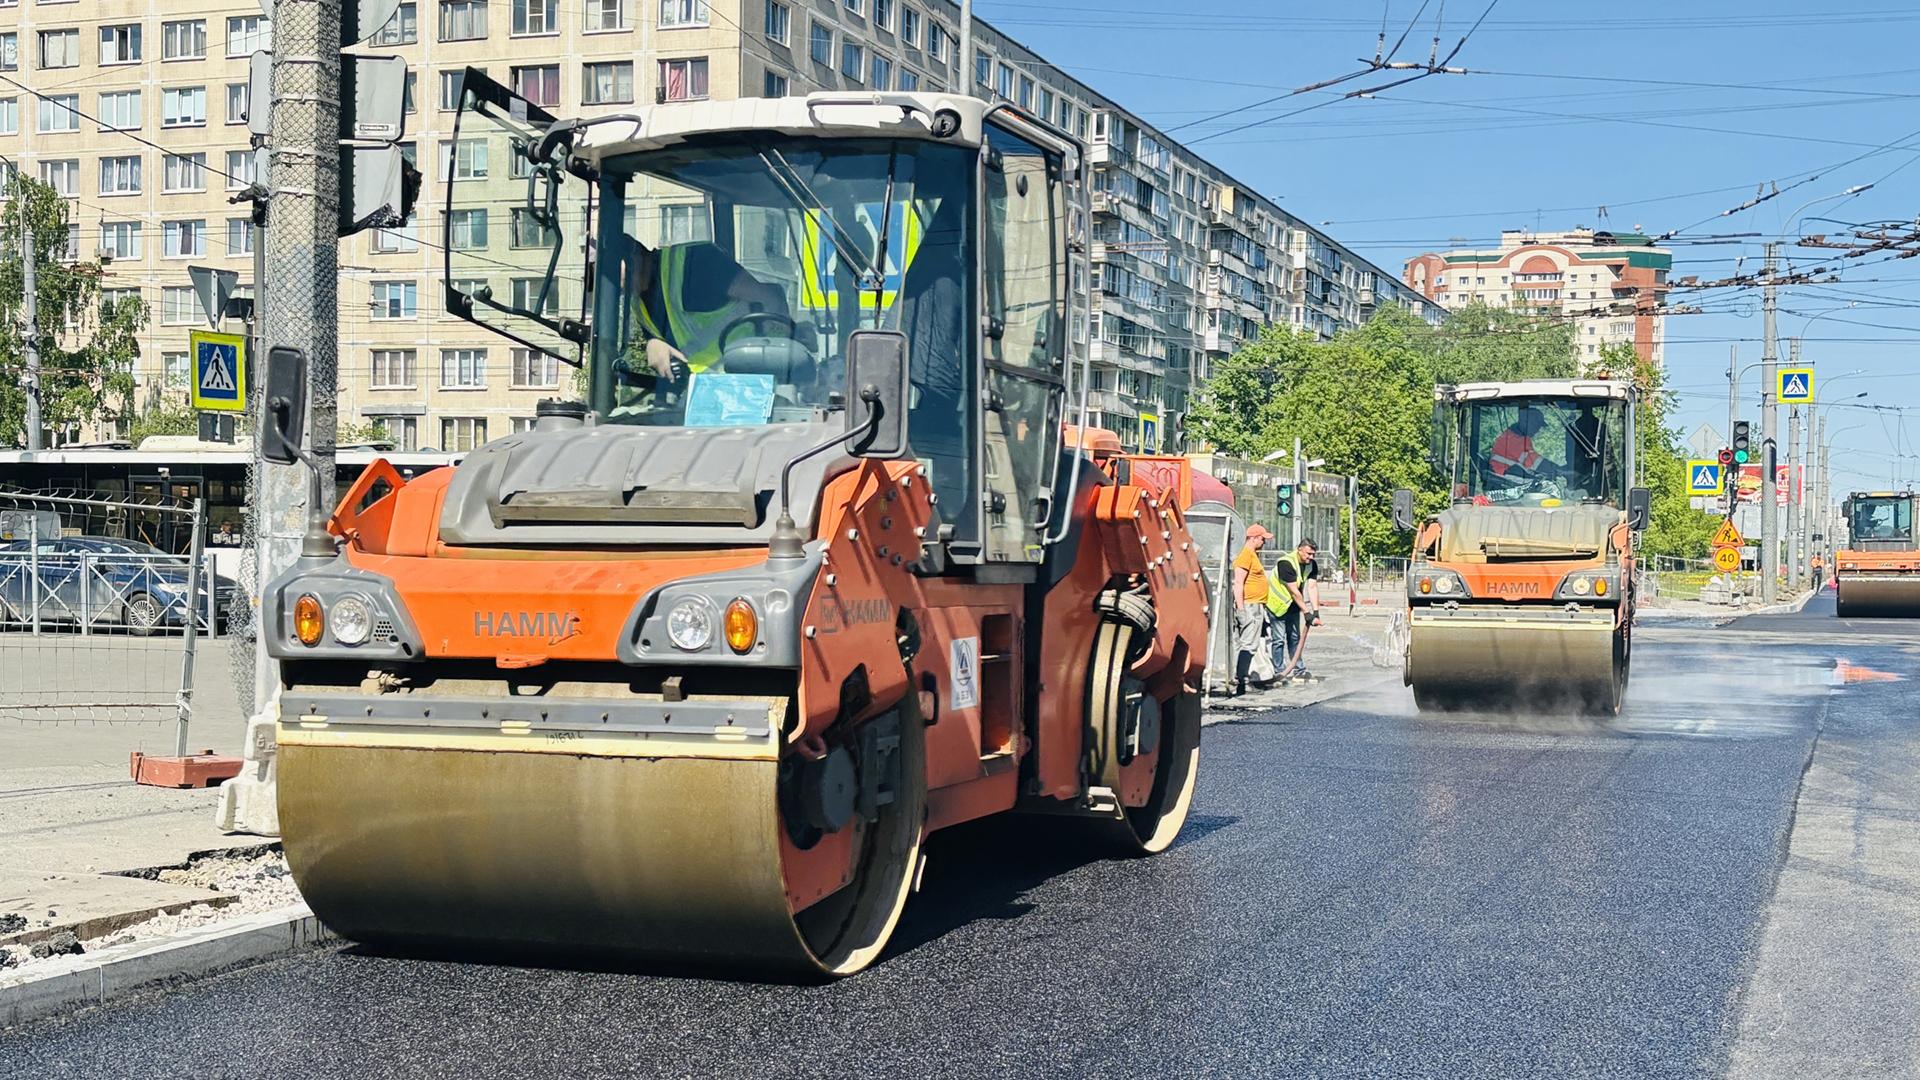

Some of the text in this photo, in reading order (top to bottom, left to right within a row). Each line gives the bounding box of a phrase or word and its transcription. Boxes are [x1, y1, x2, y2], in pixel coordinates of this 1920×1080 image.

[1720, 553, 1735, 563] 40
[1487, 582, 1539, 594] HAMM
[475, 611, 574, 637] HAMM
